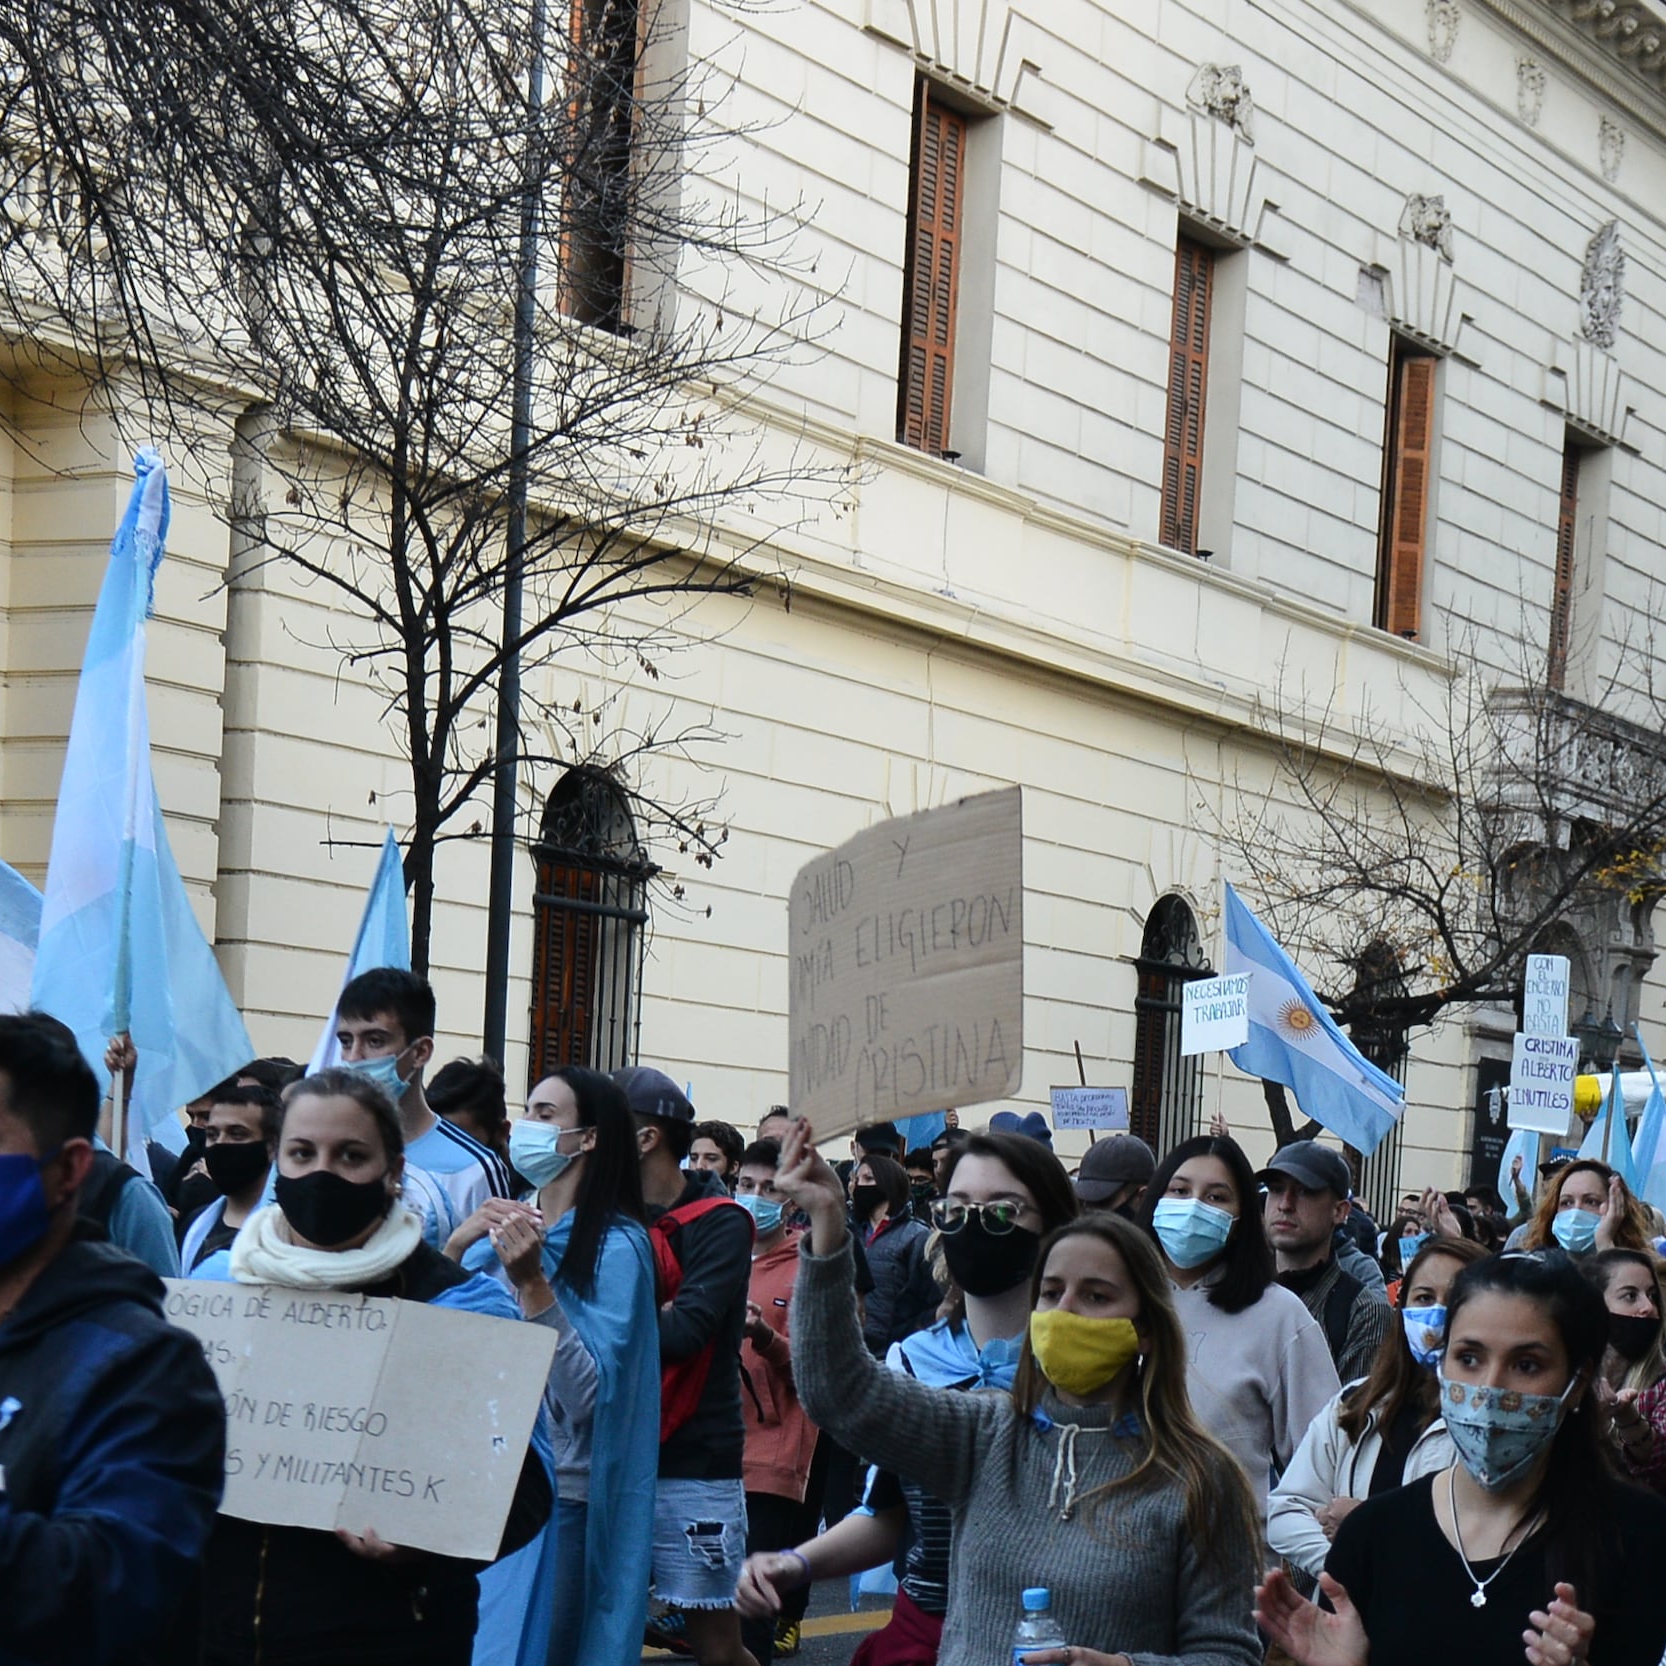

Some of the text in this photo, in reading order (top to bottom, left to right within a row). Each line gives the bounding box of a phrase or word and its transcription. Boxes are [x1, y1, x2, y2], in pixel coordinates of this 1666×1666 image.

[892, 834, 911, 880] Y
[855, 886, 1014, 974] ELIGIERON
[1534, 957, 1554, 973] CON
[1538, 970, 1548, 981] EL
[865, 992, 890, 1044] DE
[1193, 998, 1246, 1024] TRABAJAR
[1537, 998, 1551, 1014] NO
[1526, 1014, 1559, 1035] BASTA
[1525, 1037, 1574, 1060] CRISTINA
[855, 1016, 1012, 1122] CRISTINA
[1520, 1058, 1574, 1082] ALBERTO
[1513, 1087, 1570, 1110] INUTILES
[264, 1400, 294, 1428] DE
[303, 1402, 388, 1438] RIESGO
[253, 1453, 271, 1480] Y
[272, 1456, 415, 1498] MILITANTES
[422, 1475, 446, 1504] K
